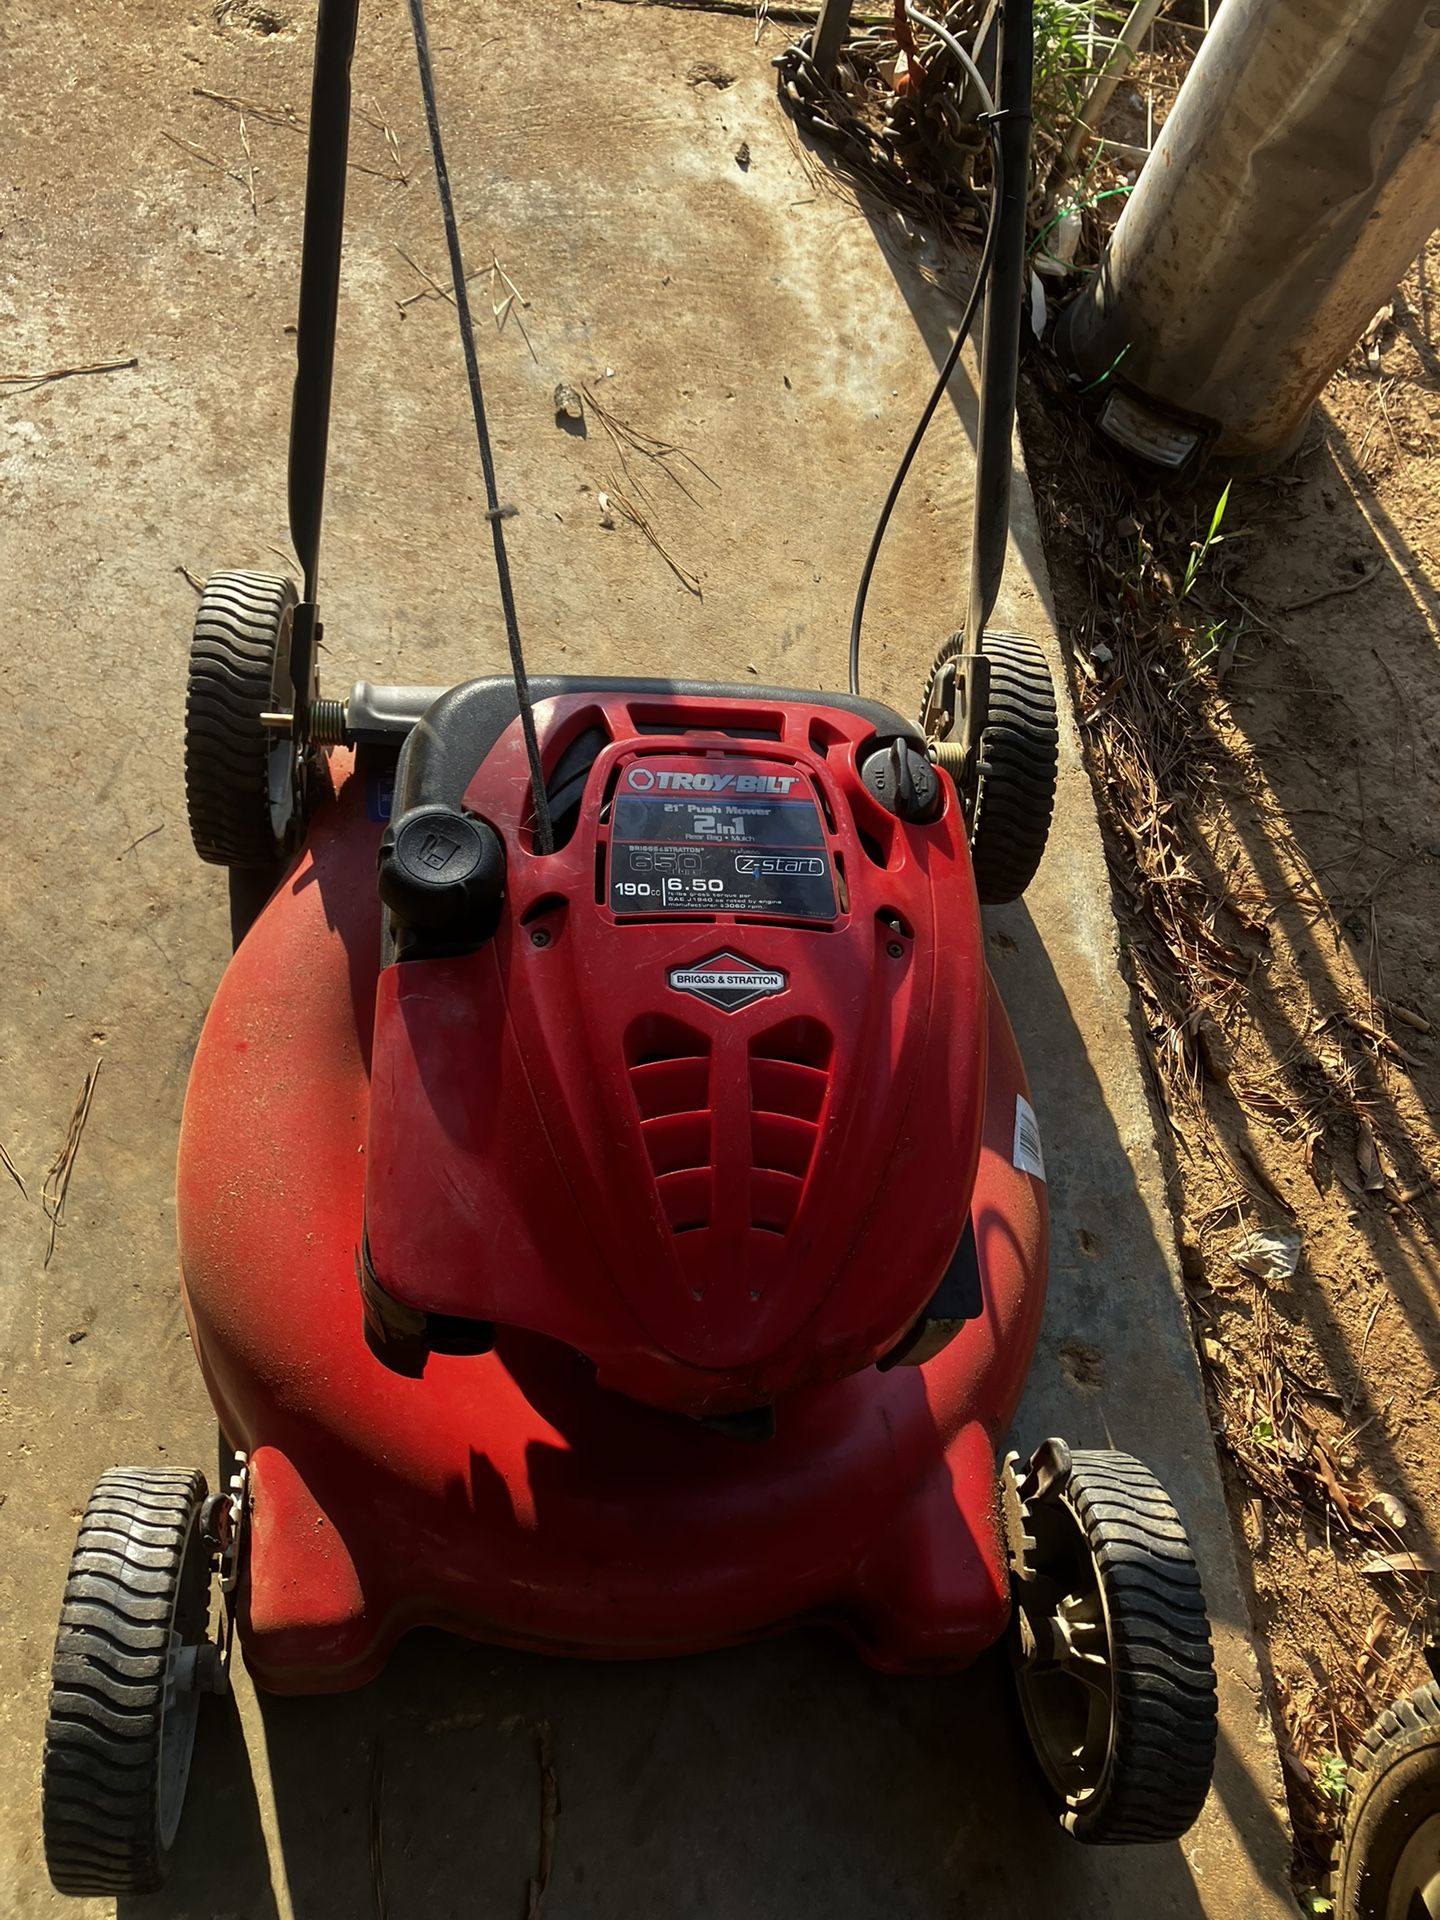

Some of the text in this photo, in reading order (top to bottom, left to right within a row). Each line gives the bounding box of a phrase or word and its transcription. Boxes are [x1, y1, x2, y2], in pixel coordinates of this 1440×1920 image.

[654, 771, 797, 794] TROY-BILT
[875, 768, 886, 790] OIL
[687, 804, 722, 813] Push
[725, 806, 771, 816] Mower
[706, 834, 723, 842] Bag
[629, 852, 703, 872] 650
[667, 878, 724, 892] 6.50
[677, 975, 778, 985] BRIGGS & STRATTON
